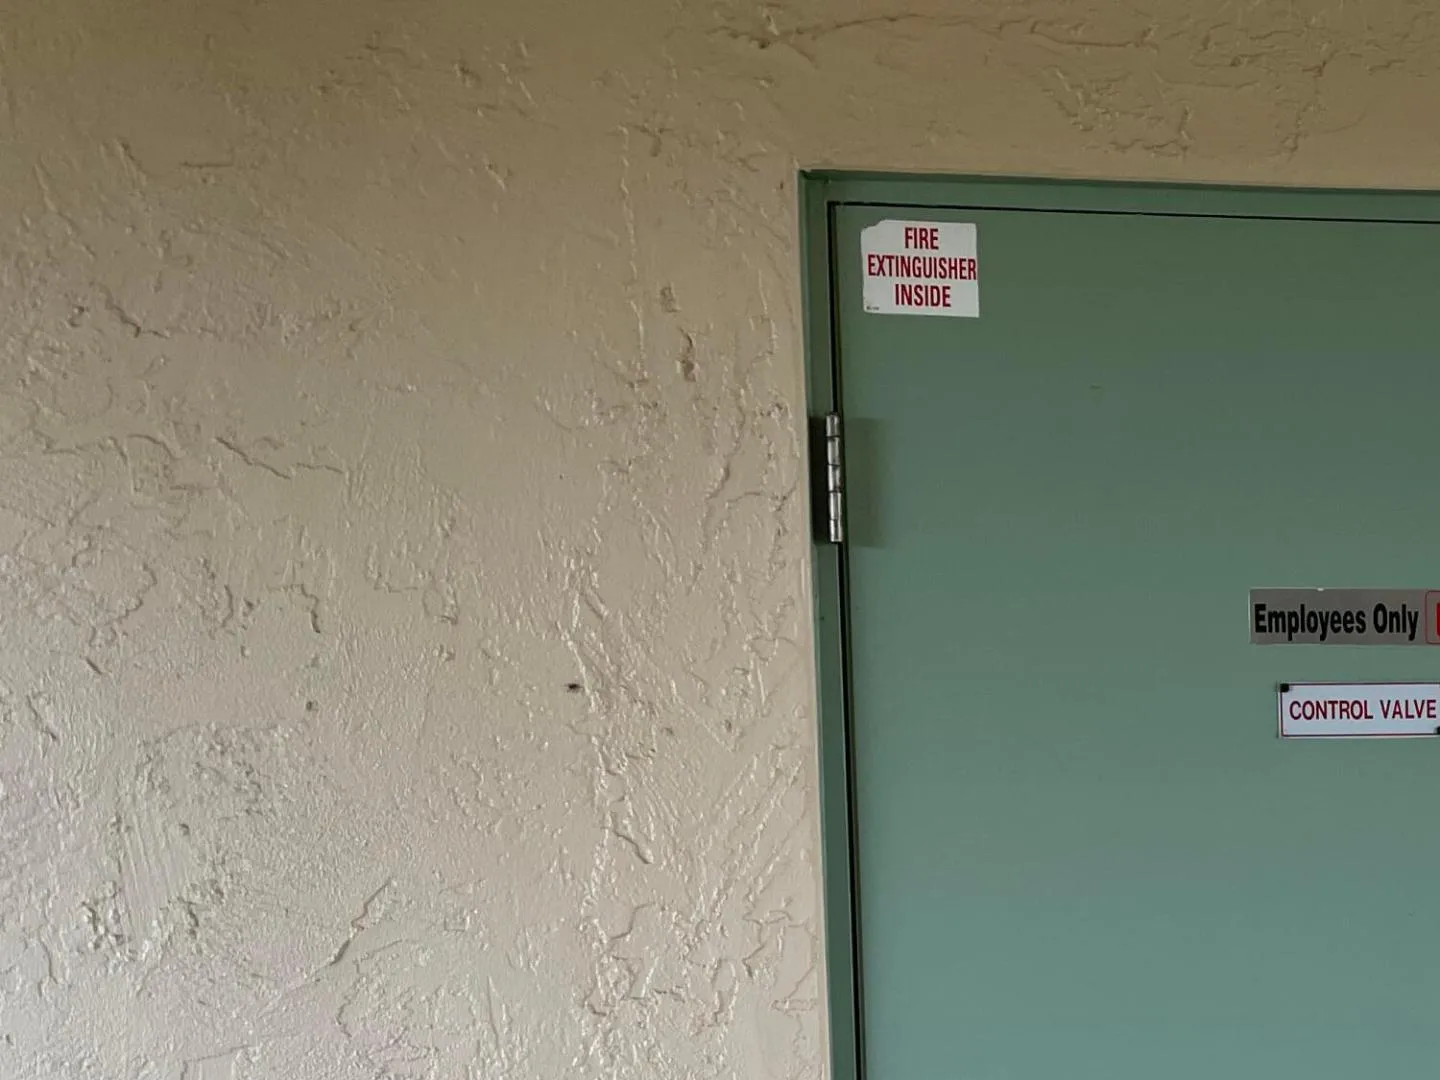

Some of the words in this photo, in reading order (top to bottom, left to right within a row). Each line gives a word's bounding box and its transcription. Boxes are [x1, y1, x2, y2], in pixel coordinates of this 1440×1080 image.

[904, 226, 939, 250] FIRE
[867, 253, 977, 280] EXTINGUISHER
[894, 283, 951, 308] INSIDE
[1254, 603, 1366, 641] Employees
[1373, 602, 1419, 641] Only
[1289, 700, 1373, 720] CONTROL
[1380, 699, 1437, 719] VALVE
